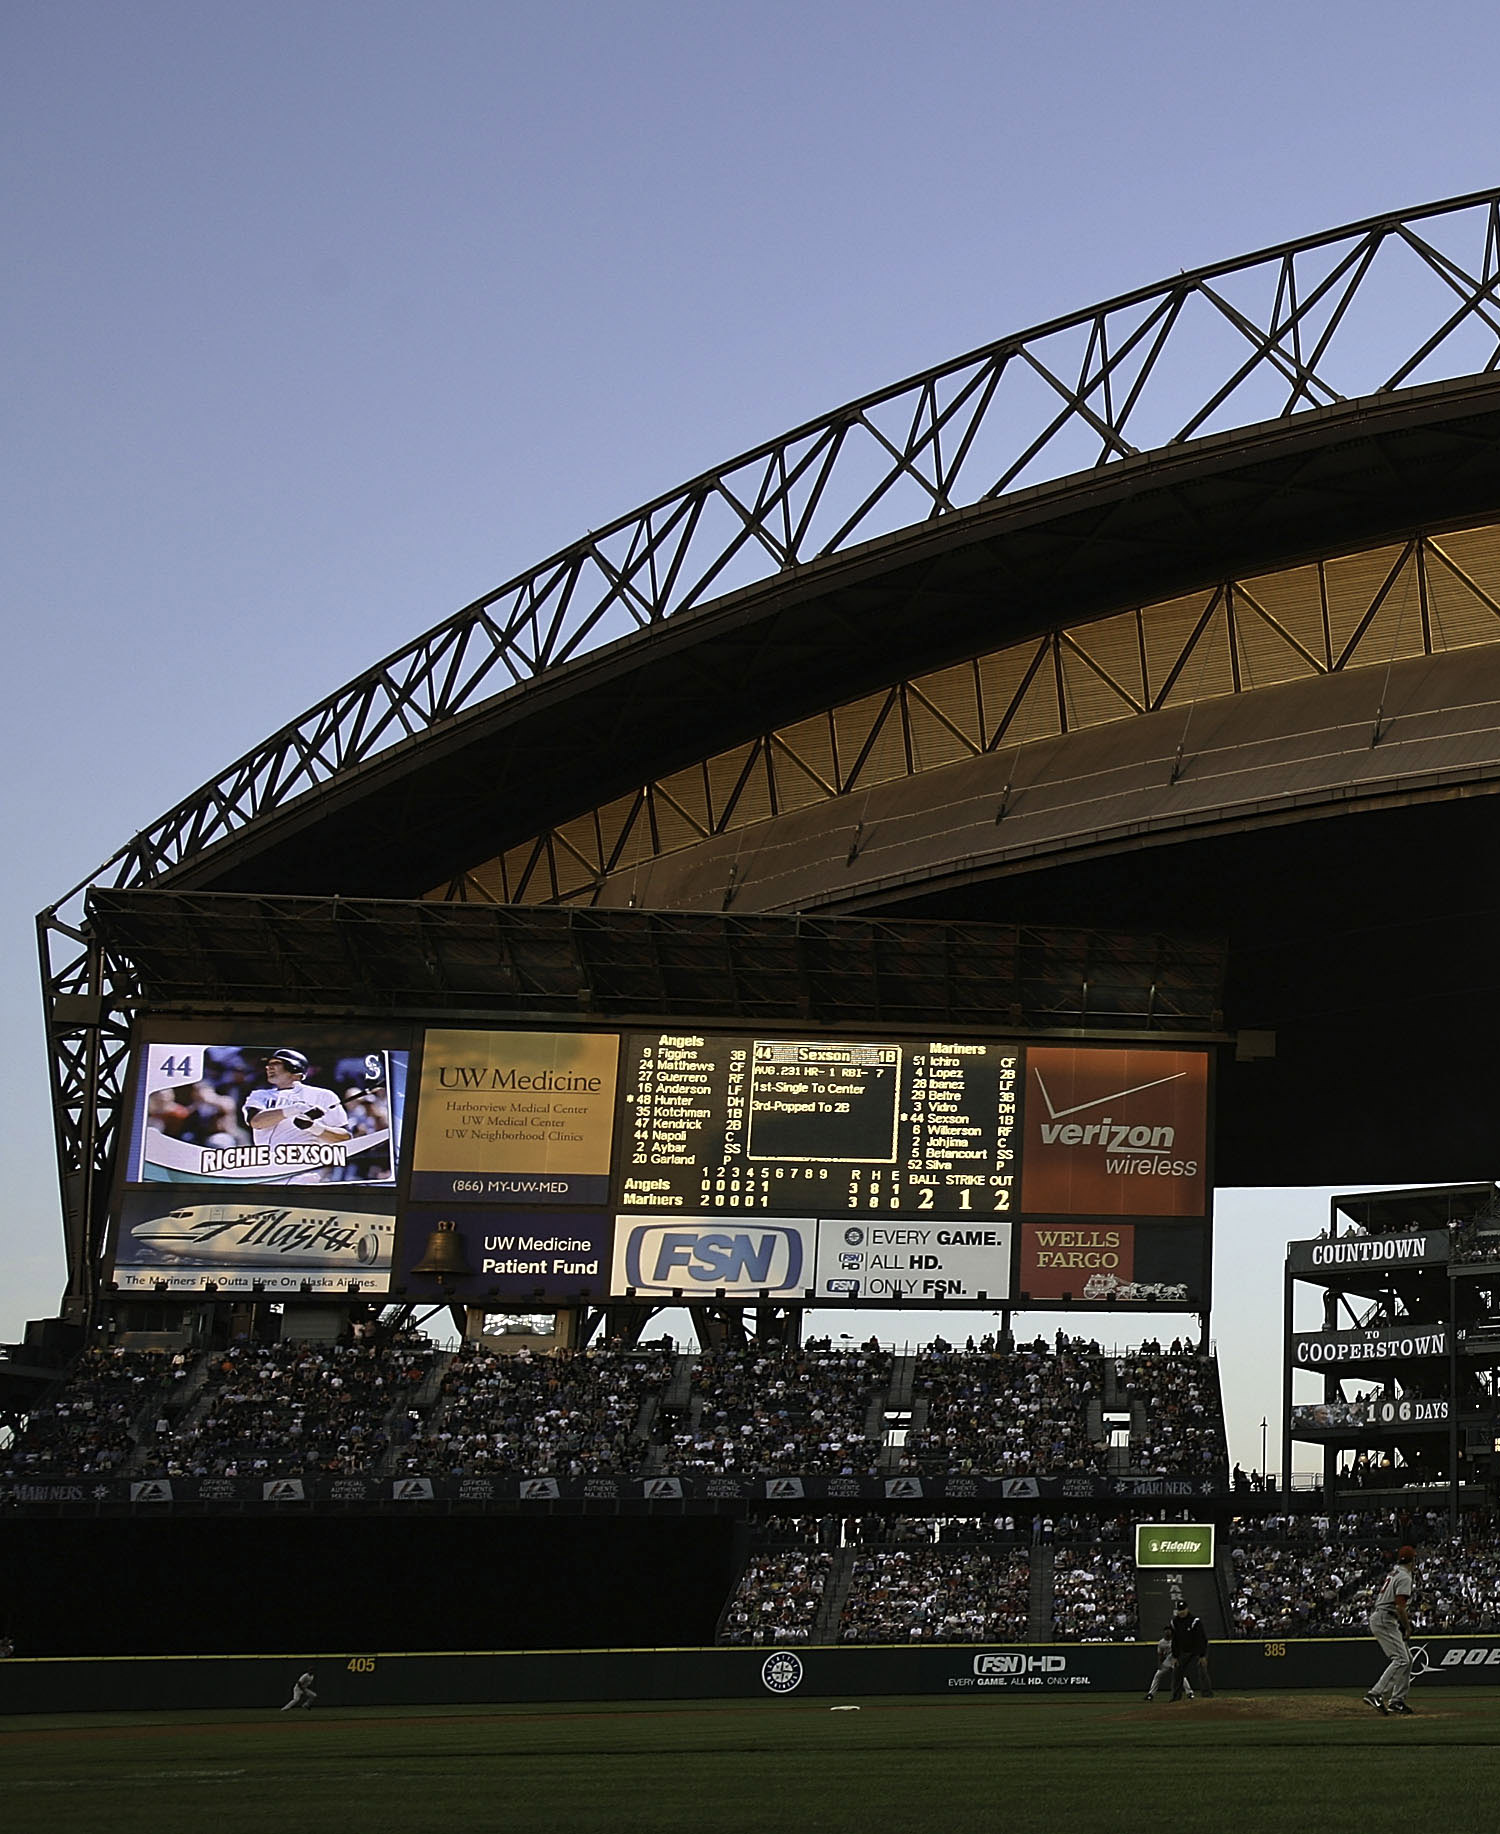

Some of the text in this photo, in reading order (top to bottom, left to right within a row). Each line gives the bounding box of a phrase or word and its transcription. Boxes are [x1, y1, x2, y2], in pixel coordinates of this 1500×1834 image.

[659, 1034, 705, 1048] Angels
[657, 1048, 698, 1060] Figgins
[929, 1043, 986, 1055] Mariners
[160, 1055, 193, 1077] 44
[657, 1060, 715, 1071] Matthews
[930, 1056, 960, 1067] Ichiro
[439, 1067, 601, 1091] UW Medicine
[656, 1072, 708, 1083] Guerrero
[929, 1068, 964, 1080] Lopez
[655, 1083, 711, 1094] Anderson
[753, 1082, 865, 1095] 1st-Single To Center
[928, 1079, 965, 1090] Ibanez
[654, 1094, 694, 1105] Hunter
[928, 1090, 962, 1101] Beltre
[446, 1102, 589, 1114] Harborview Medical Center
[653, 1106, 711, 1118] Kotchman
[752, 1101, 850, 1113] 3rd-Popped To 2B
[928, 1102, 958, 1112] Vidro
[462, 1115, 565, 1127] UW Medical Center
[652, 1118, 702, 1130] Kendrick
[927, 1113, 970, 1124] Sexson
[445, 1129, 583, 1142] UW Neighborhood Clinics
[652, 1130, 687, 1142] Napoli
[927, 1125, 982, 1136] Wilkerson
[1040, 1117, 1175, 1153] verizon
[651, 1142, 687, 1154] Aybar
[926, 1137, 969, 1148] Johjima
[201, 1144, 346, 1173] RICHIE SEXSON
[650, 1154, 695, 1165] Garland
[925, 1148, 988, 1159] Betancourt
[925, 1160, 952, 1170] Silva
[1106, 1155, 1198, 1176] wireless
[909, 1174, 1014, 1186] BALL STRIKE OUT
[452, 1180, 569, 1193] (866) MY-UW-MED
[918, 1188, 1010, 1210] 2 1 2
[189, 1209, 358, 1253] Alaska
[484, 1236, 592, 1251] UW Medicine
[872, 1230, 1002, 1246] EVERY GAME.
[1035, 1231, 1120, 1248] WELLS
[652, 1232, 777, 1282] FSN
[1312, 1237, 1427, 1265] COUNTDOWN
[870, 1254, 943, 1270] ALL HD.
[1036, 1252, 1119, 1268] FARGO
[482, 1259, 599, 1275] Patient Fund
[126, 1276, 146, 1285] The
[149, 1276, 196, 1286] Mariners
[218, 1277, 248, 1286] Outta
[252, 1277, 278, 1287] Here
[280, 1278, 297, 1287] On
[300, 1277, 333, 1287] Alaska
[870, 1279, 967, 1295] ONLY FSN.
[1365, 1330, 1379, 1339] TO
[1297, 1333, 1446, 1362] COOPERSTOWN
[1415, 1402, 1448, 1420] DAYS
[1133, 1481, 1194, 1495] MARINERS
[1160, 1541, 1202, 1553] Fidelity
[1264, 1643, 1286, 1657] 385
[347, 1658, 376, 1673] 405
[981, 1655, 1066, 1673] FSN HD
[948, 1676, 1091, 1687] EVERY GAME. ALL HD. ONLY FSN.
